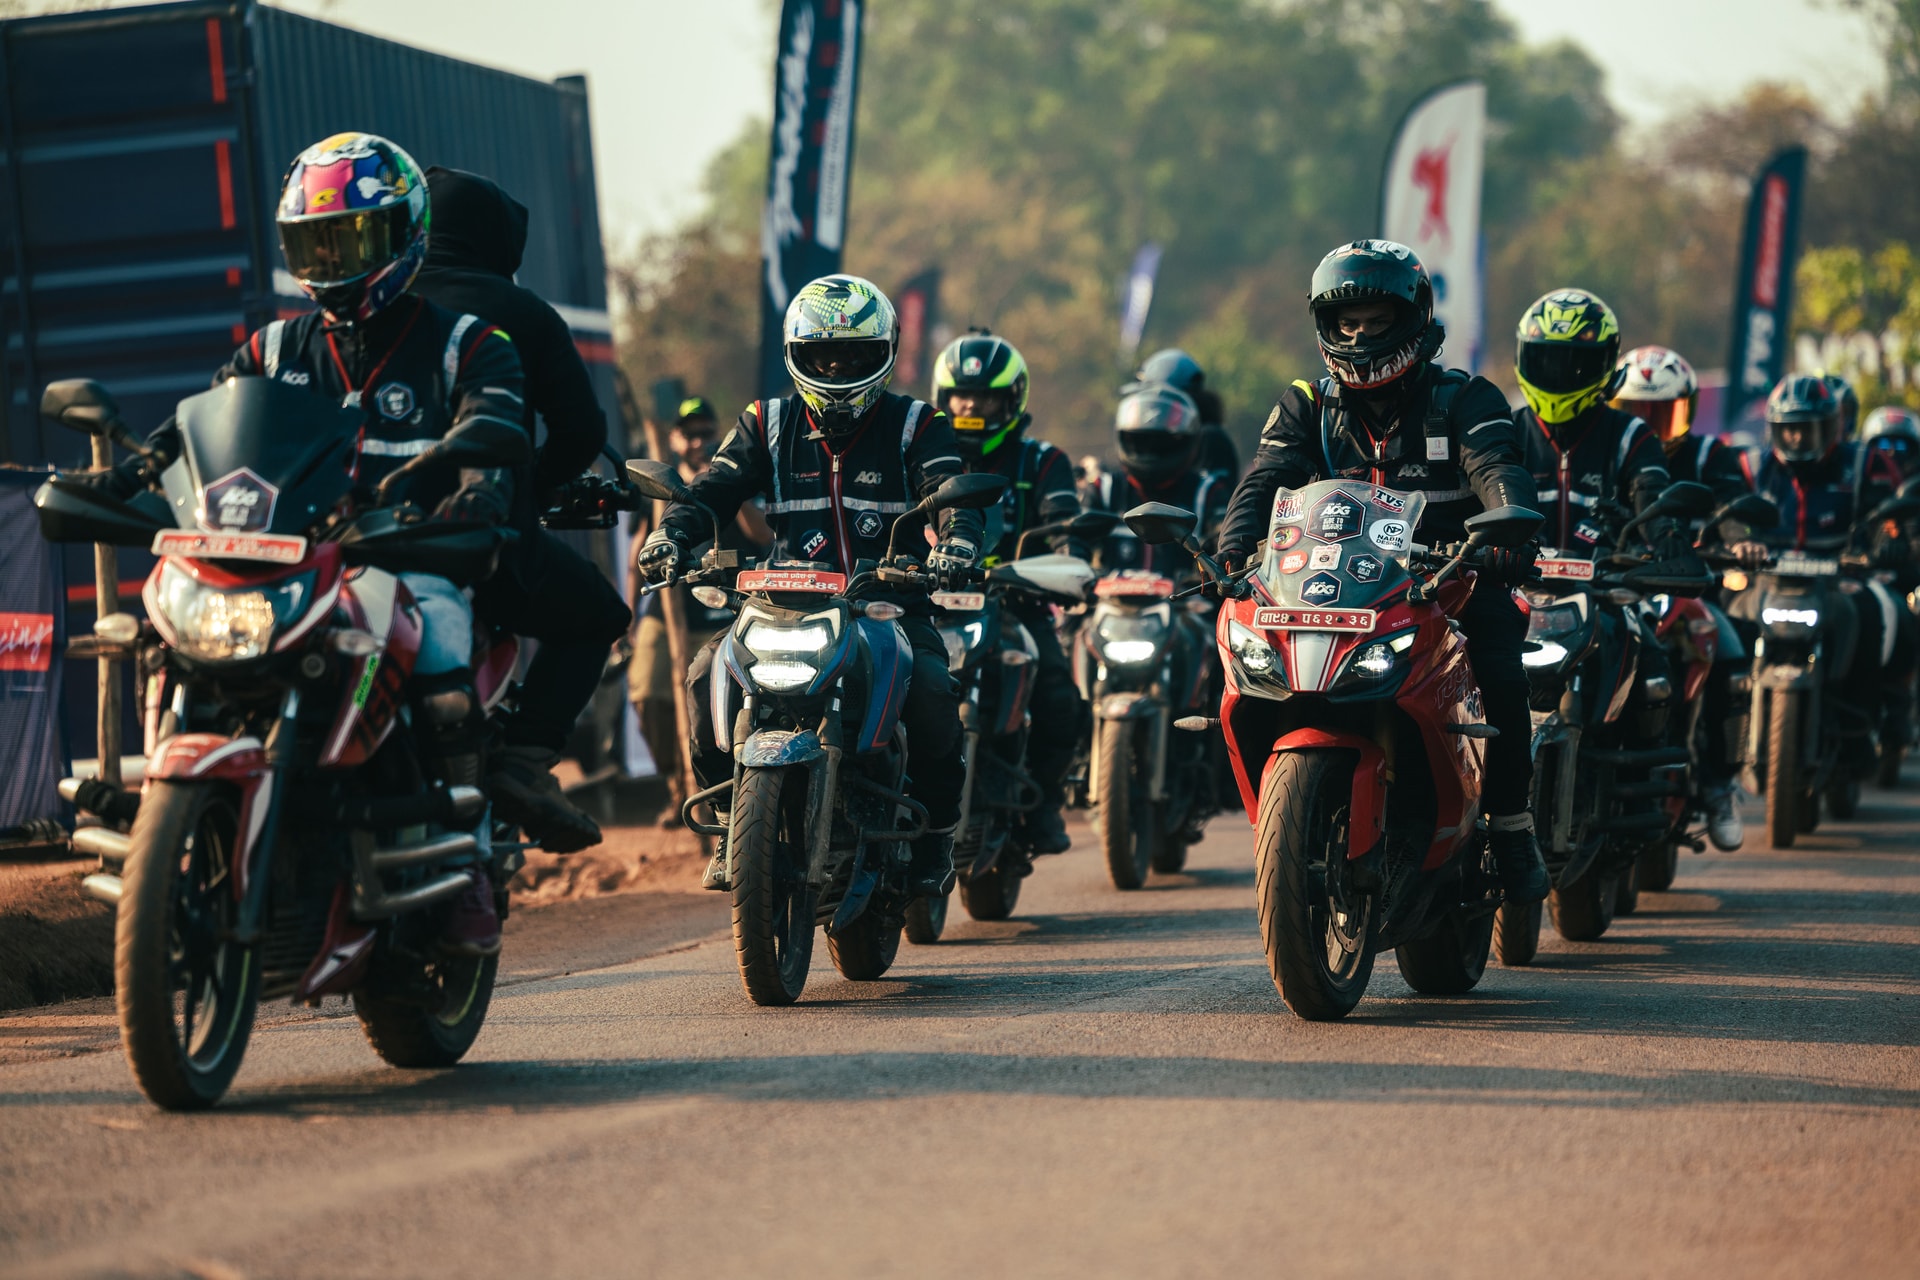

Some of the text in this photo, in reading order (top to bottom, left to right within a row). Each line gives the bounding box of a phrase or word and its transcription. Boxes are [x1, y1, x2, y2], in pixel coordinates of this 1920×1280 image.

[854, 470, 882, 485] AOG
[1376, 490, 1404, 507] TVS
[1320, 505, 1351, 517] AOG
[803, 532, 824, 553] TVS
[1303, 584, 1336, 596] AOG
